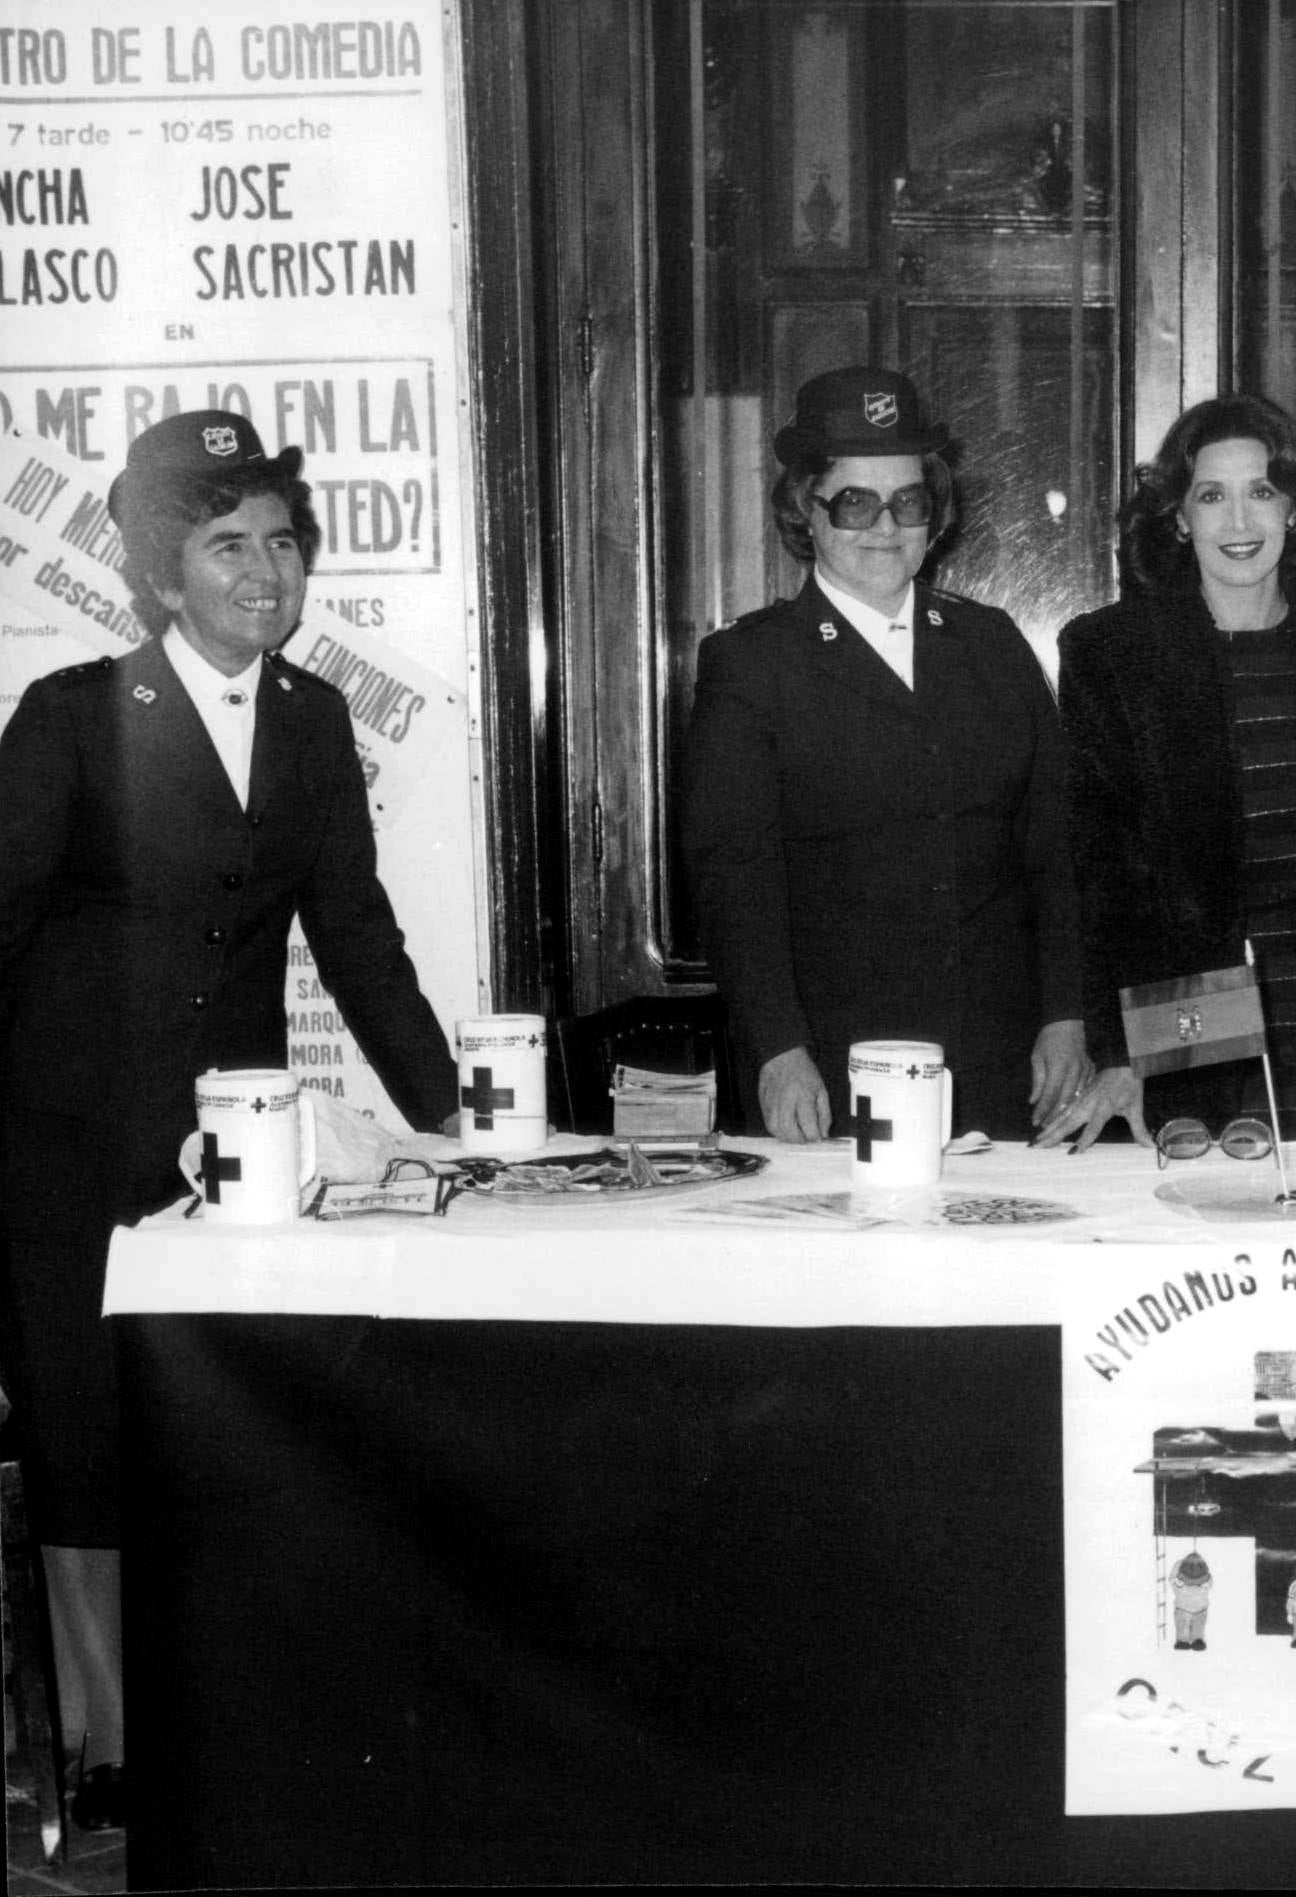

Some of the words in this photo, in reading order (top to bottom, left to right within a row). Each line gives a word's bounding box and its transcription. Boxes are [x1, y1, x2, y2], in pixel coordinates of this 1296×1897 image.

[91, 27, 141, 85] DE
[166, 26, 215, 83] LA
[240, 20, 422, 81] COMEDIA
[8, 123, 24, 146] 7
[37, 122, 111, 146] tarde
[248, 118, 332, 141] noche
[190, 162, 293, 222] JOSE
[0, 247, 118, 306] LASCO
[193, 239, 416, 300] SACRISTAN
[164, 323, 195, 341] EN
[36, 386, 105, 461] ME
[275, 379, 337, 454] EN
[357, 378, 420, 453] LA
[4, 456, 70, 524] HOY
[316, 478, 423, 554] TED?
[34, 556, 152, 645] descans
[302, 633, 426, 744] FUNCIONES
[291, 1044, 343, 1067] MORA
